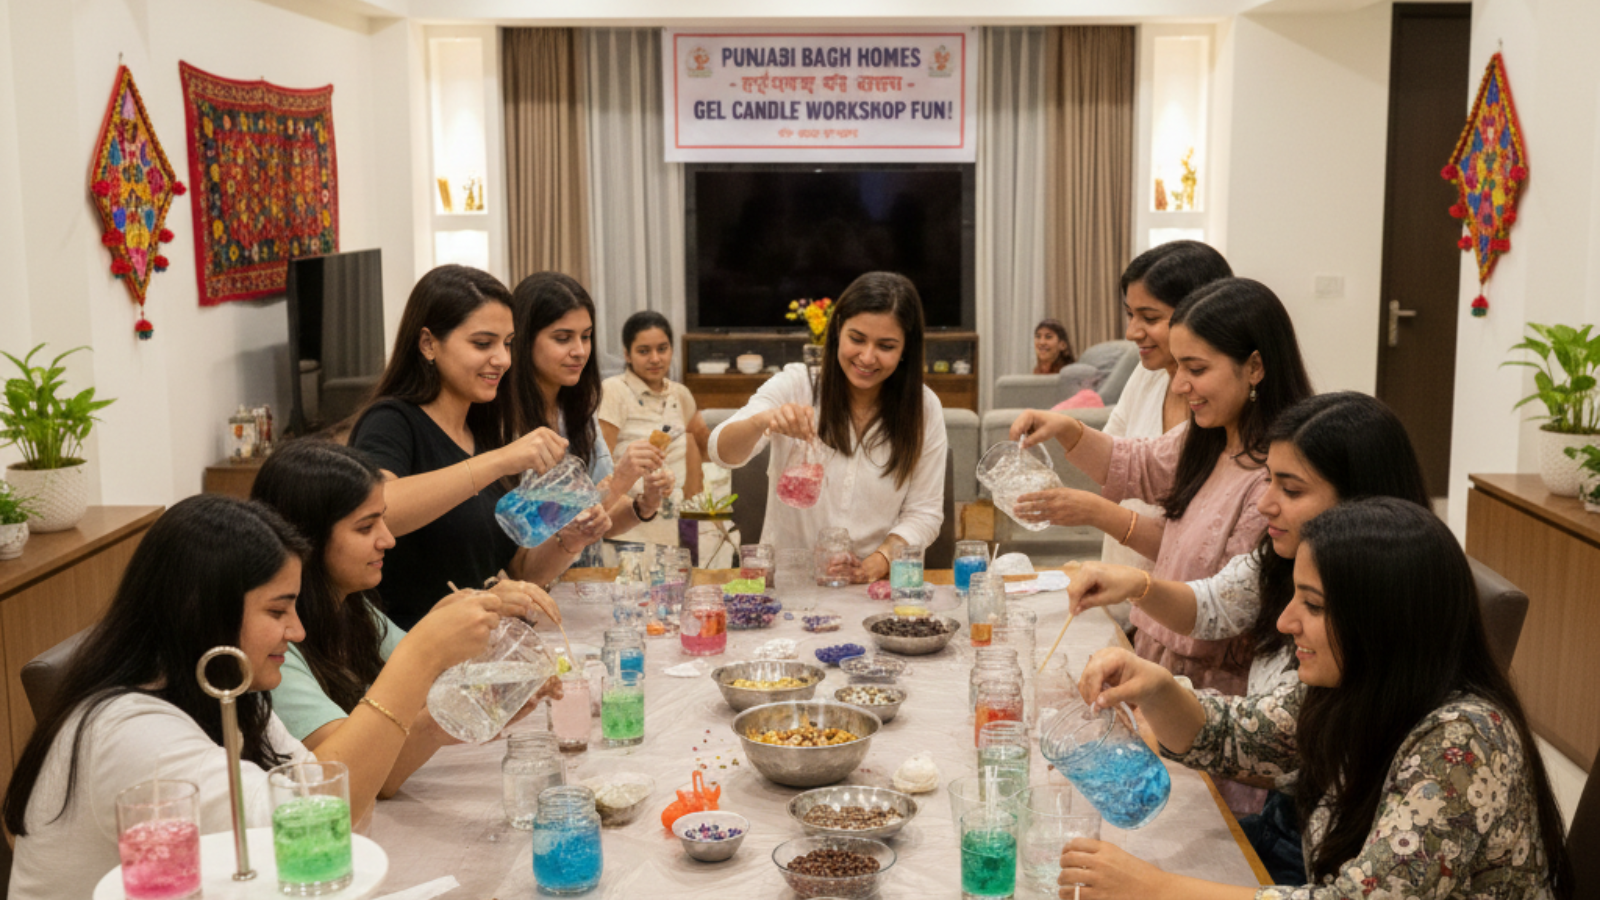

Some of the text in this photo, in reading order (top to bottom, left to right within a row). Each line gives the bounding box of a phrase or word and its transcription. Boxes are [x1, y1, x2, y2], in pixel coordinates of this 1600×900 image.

[801, 46, 852, 68] BAGH
[857, 46, 922, 68] HOMES
[693, 100, 953, 121] GEL CANDLE WORKSHOP FUN!
